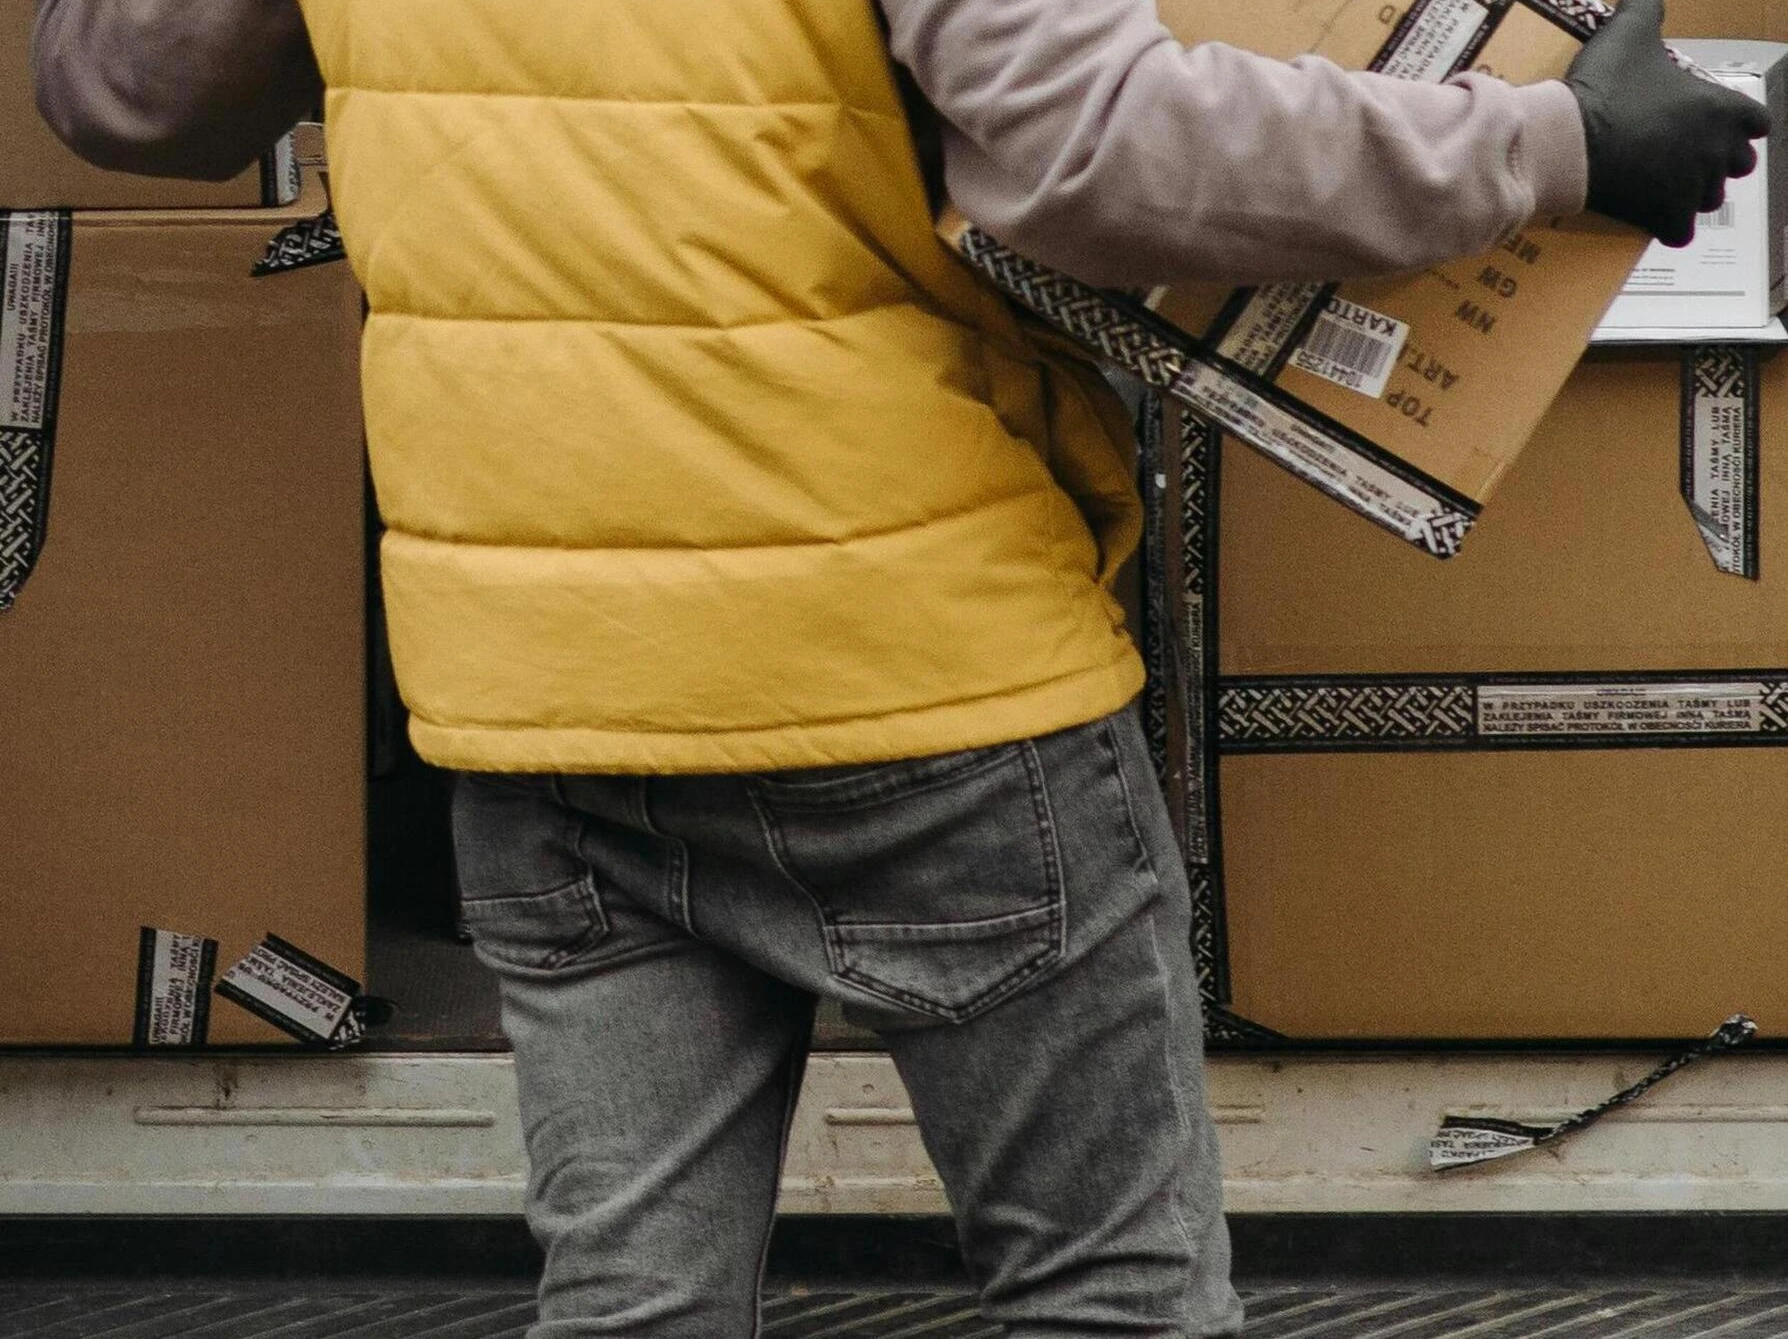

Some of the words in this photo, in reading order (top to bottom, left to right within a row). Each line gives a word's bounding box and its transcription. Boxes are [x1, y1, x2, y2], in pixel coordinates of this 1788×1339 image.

[17, 242, 33, 324] USZKODZENIA
[31, 244, 44, 302] FIRMOWEJ
[43, 274, 52, 285] W
[26, 310, 38, 346] TAŚMY
[11, 332, 25, 403] PRZYPADKU
[20, 354, 34, 422] ZAKLEJENIA
[1386, 387, 1435, 426] TOP
[10, 411, 17, 421] W
[1720, 406, 1731, 442] TAŚMĄ
[1731, 406, 1741, 453] KURIERA
[1710, 438, 1718, 478] TAŚMY
[1732, 521, 1740, 530] W
[1482, 702, 1493, 710] W
[1502, 700, 1575, 710] PRZYPADKU
[1583, 699, 1668, 708] USZKODZENIA
[1677, 698, 1717, 707] TAŚMY
[1726, 699, 1750, 707] LUB
[1483, 711, 1553, 721] ZAKLEJENIA
[1562, 710, 1599, 719] TAŚMY
[1607, 710, 1667, 718] FIRMOWEJ
